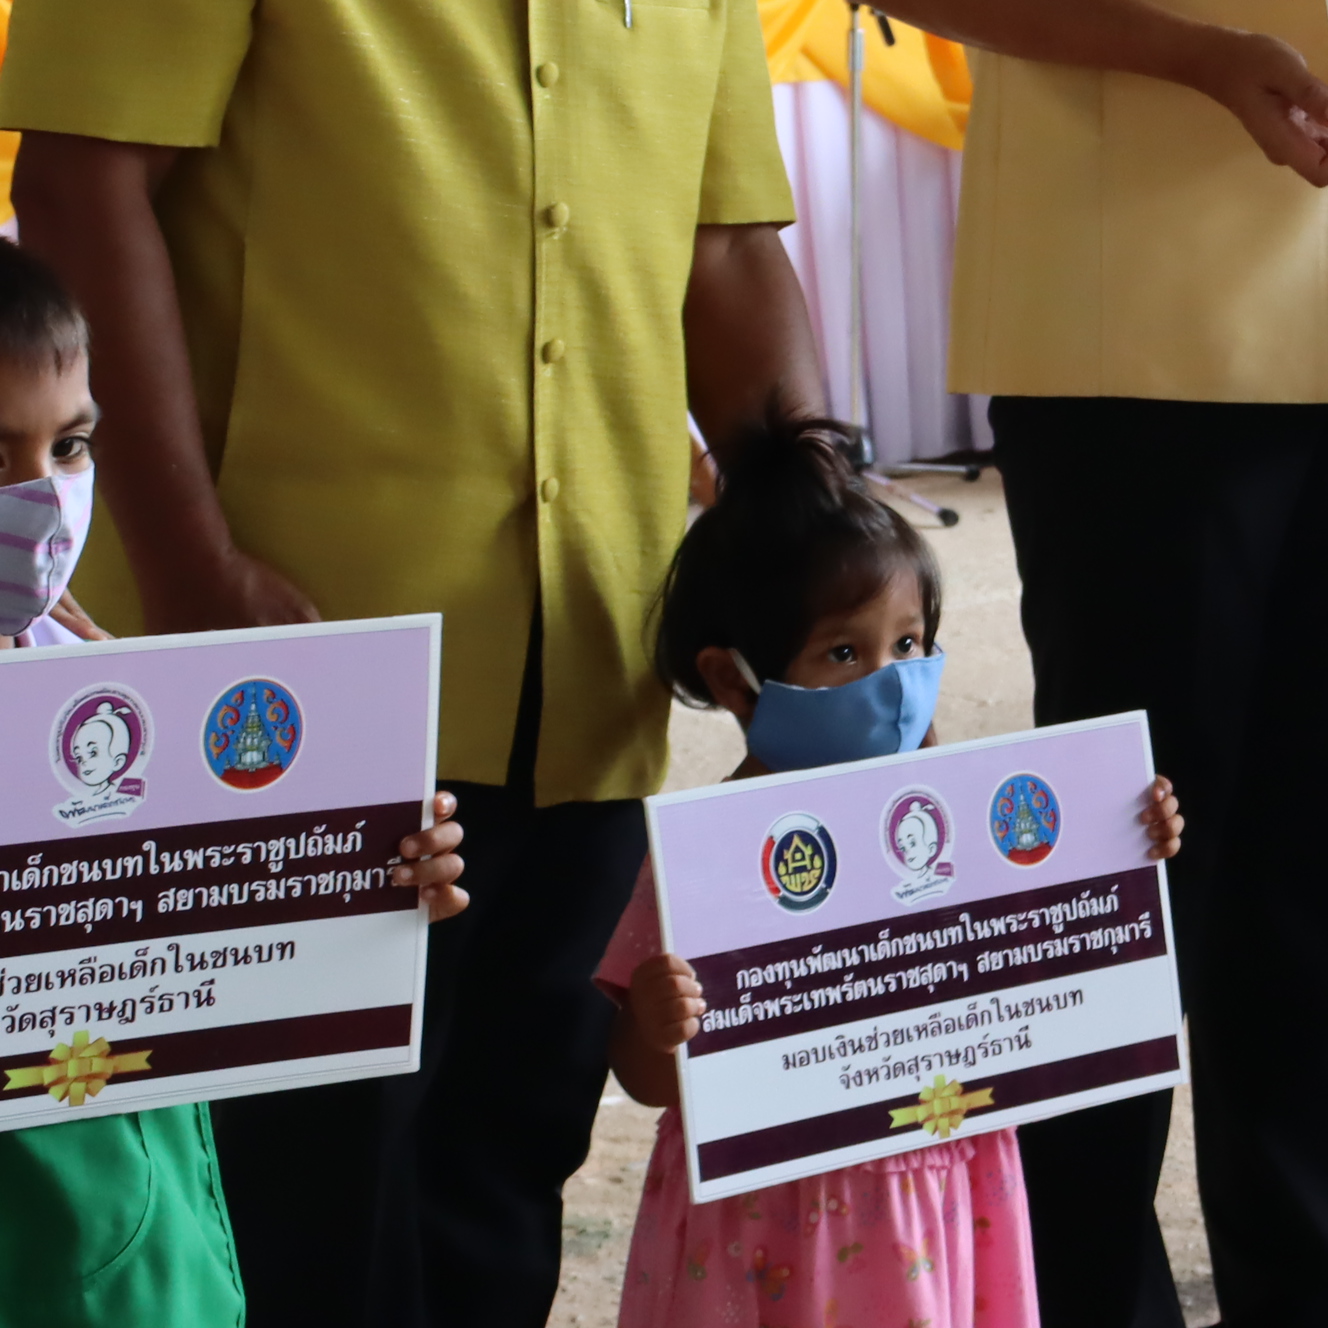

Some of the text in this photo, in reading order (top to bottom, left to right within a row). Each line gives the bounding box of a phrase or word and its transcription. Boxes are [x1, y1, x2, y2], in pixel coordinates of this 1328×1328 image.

[701, 912, 1152, 1033] สมเด็จพระเทพรัตนราชสุดาฯ สยามบรมราชกุมารี
[736, 885, 1119, 989] กองทุนพัฒนาเด็กชนบทในพระราชูปถัมภ์
[782, 988, 1084, 1071] มอบเงินช่วยเหลือเด็กในชนบท
[839, 1025, 1032, 1090] จังหวัดสุราษฎร์ธานี
